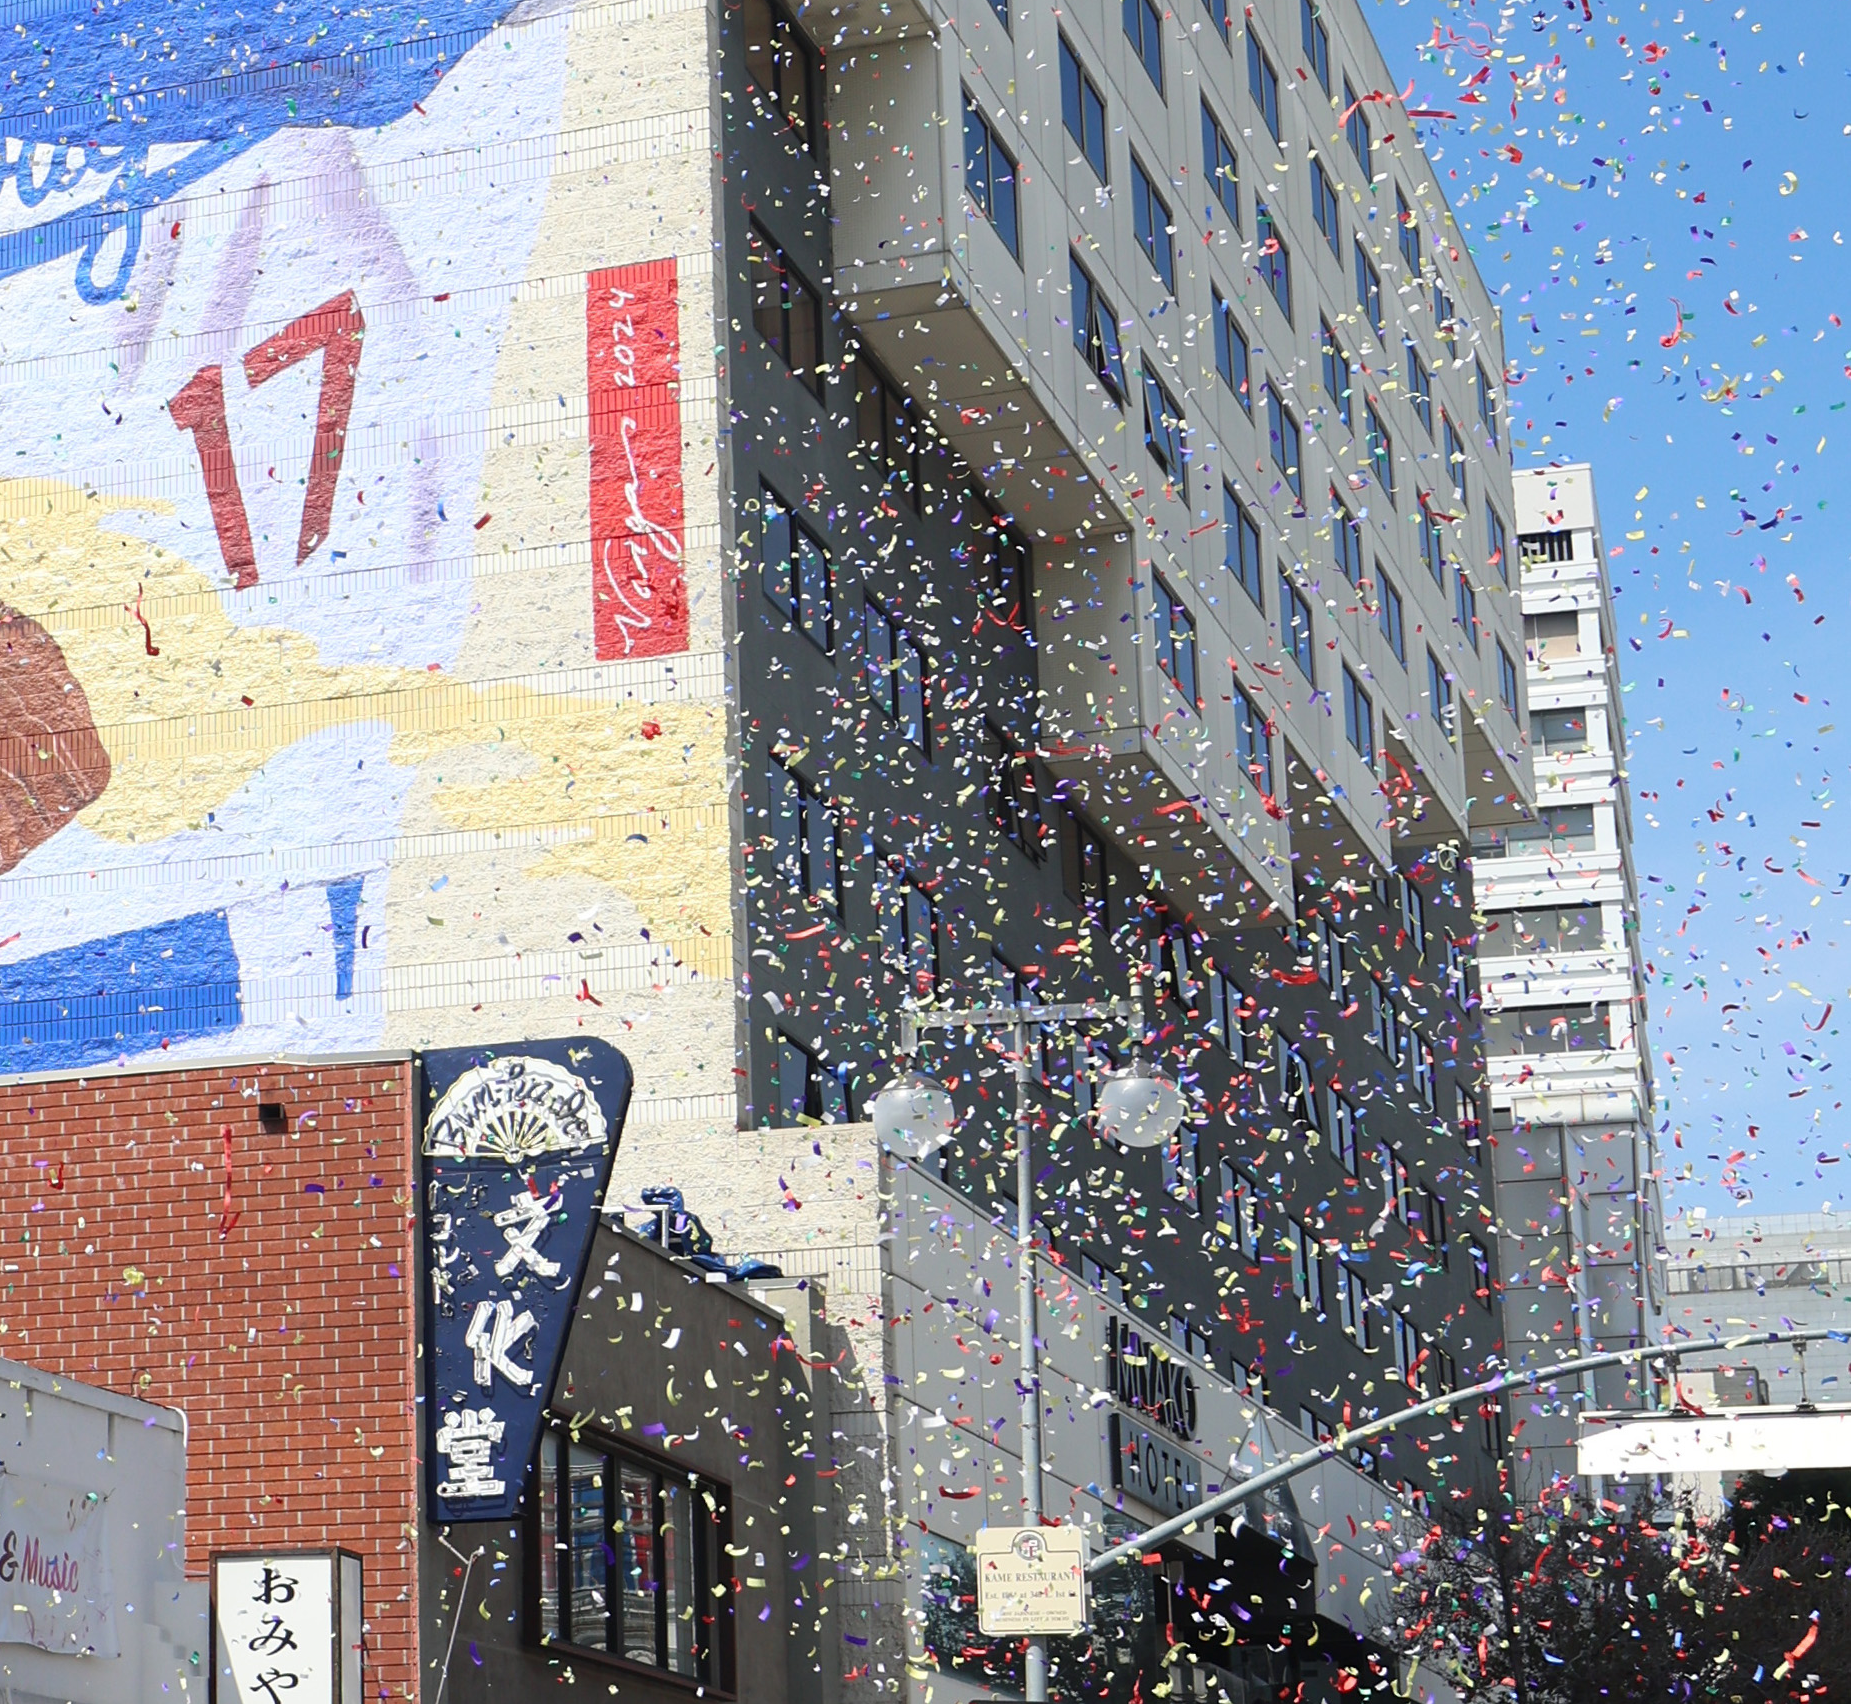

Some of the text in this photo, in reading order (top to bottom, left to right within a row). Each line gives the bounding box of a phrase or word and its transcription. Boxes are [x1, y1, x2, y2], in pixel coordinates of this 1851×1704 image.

[607, 286, 636, 390] 2024
[167, 288, 366, 592] 17
[435, 1189, 564, 1498] 文化堂
[1106, 1315, 1198, 1442] MIYAKO
[20, 1534, 80, 1594] Music
[984, 1571, 1076, 1583] KAME RESTAURANT
